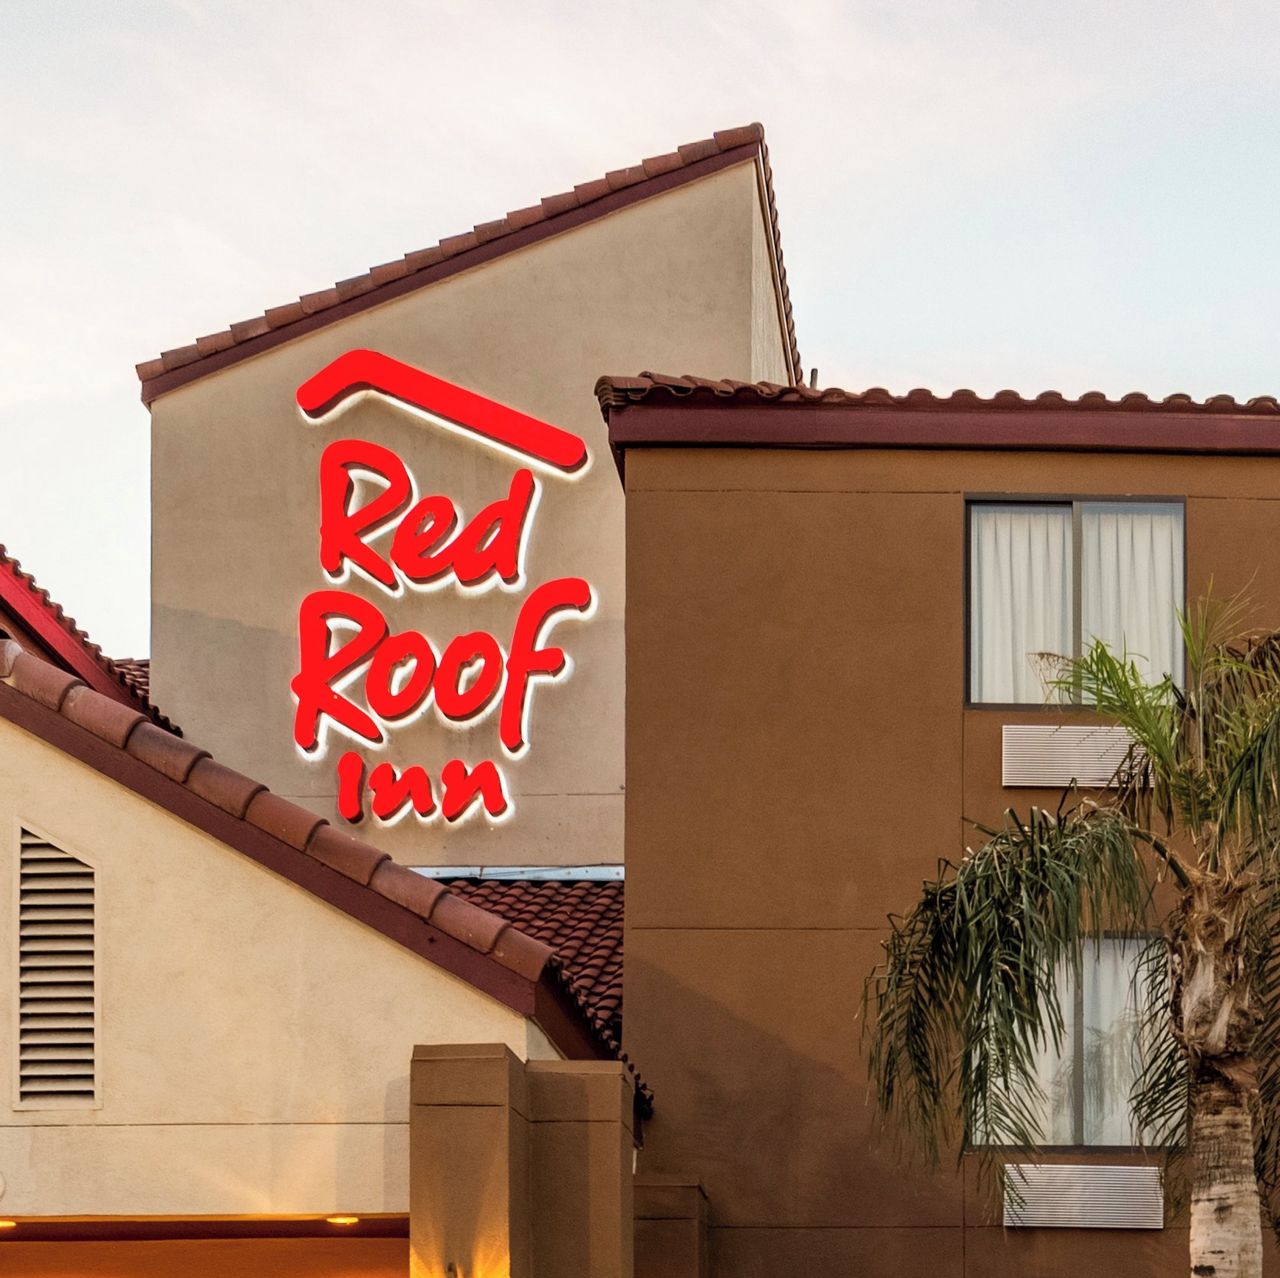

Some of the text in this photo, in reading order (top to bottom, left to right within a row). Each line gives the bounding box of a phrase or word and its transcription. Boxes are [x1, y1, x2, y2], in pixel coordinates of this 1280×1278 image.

[320, 439, 535, 588] Red
[291, 577, 593, 752] Roof
[337, 751, 508, 823] Inn
